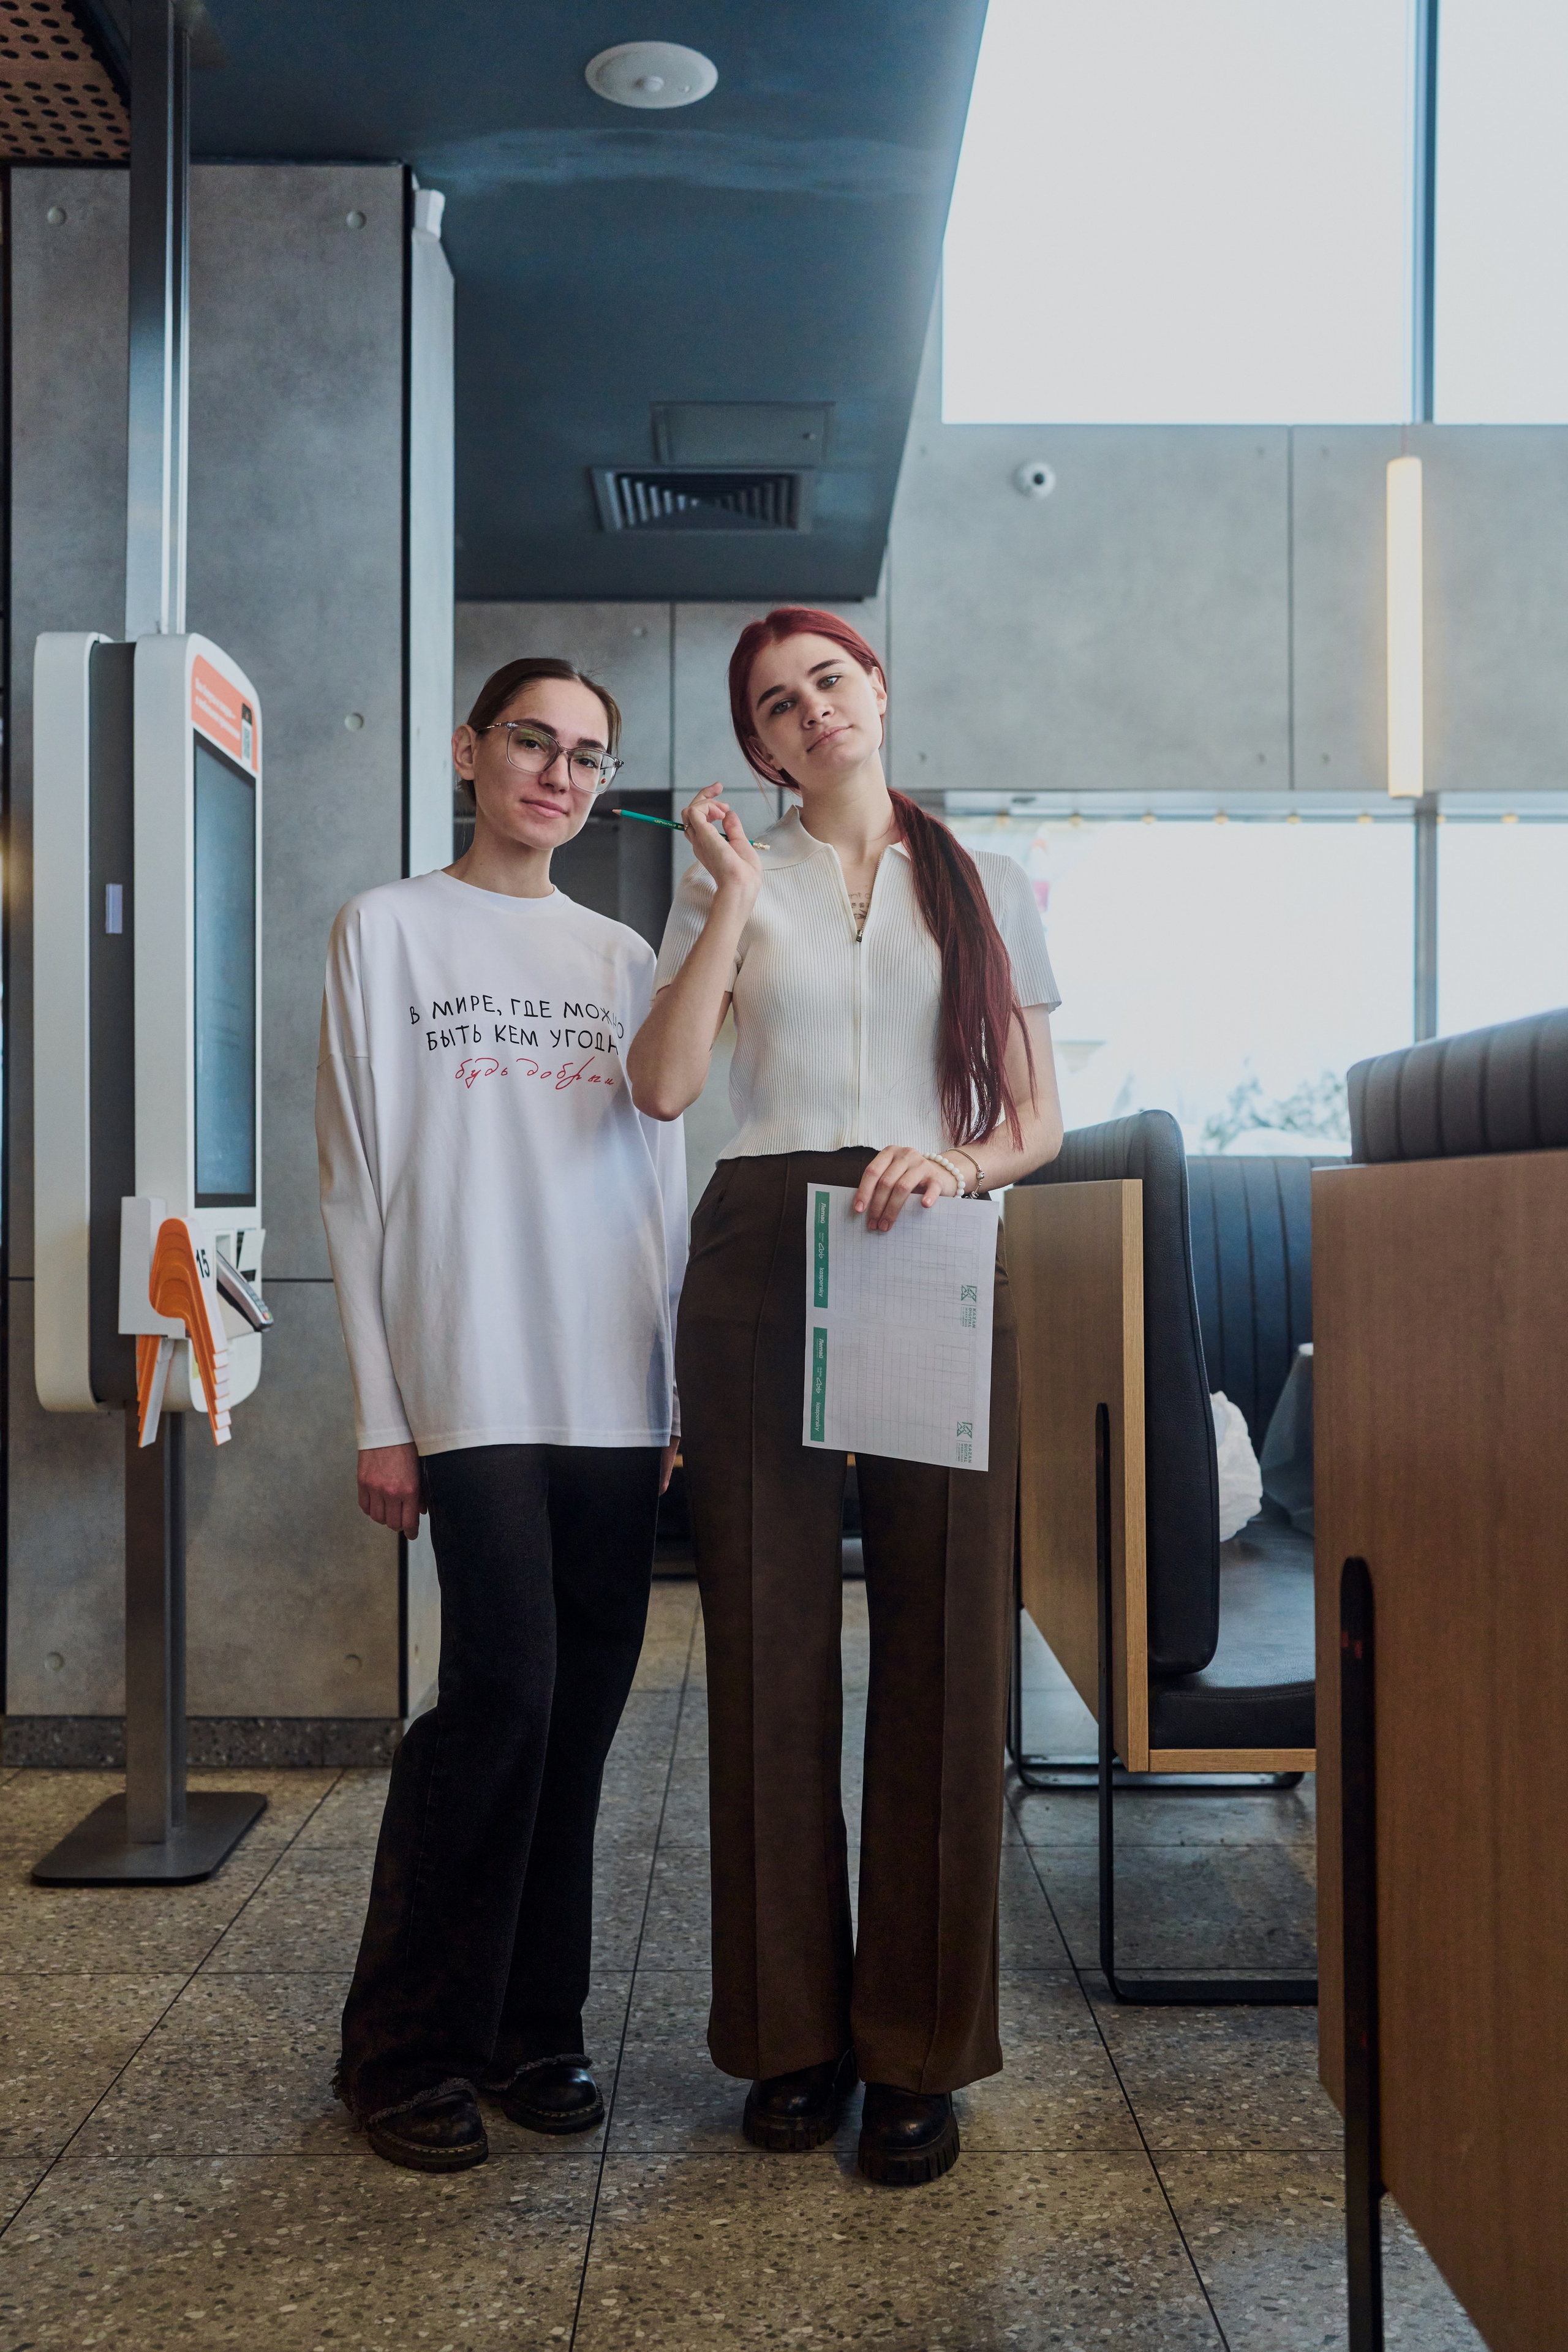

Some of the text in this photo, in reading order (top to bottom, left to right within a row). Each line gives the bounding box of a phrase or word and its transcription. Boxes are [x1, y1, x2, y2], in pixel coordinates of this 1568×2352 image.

[409, 994, 624, 1039] В МИРЕ, ГДЕ МОЖНО
[426, 1023, 619, 1055] БЫТЬ КЕМ УГОДН
[455, 1056, 614, 1090] будь добрым
[196, 1249, 210, 1278] 15
